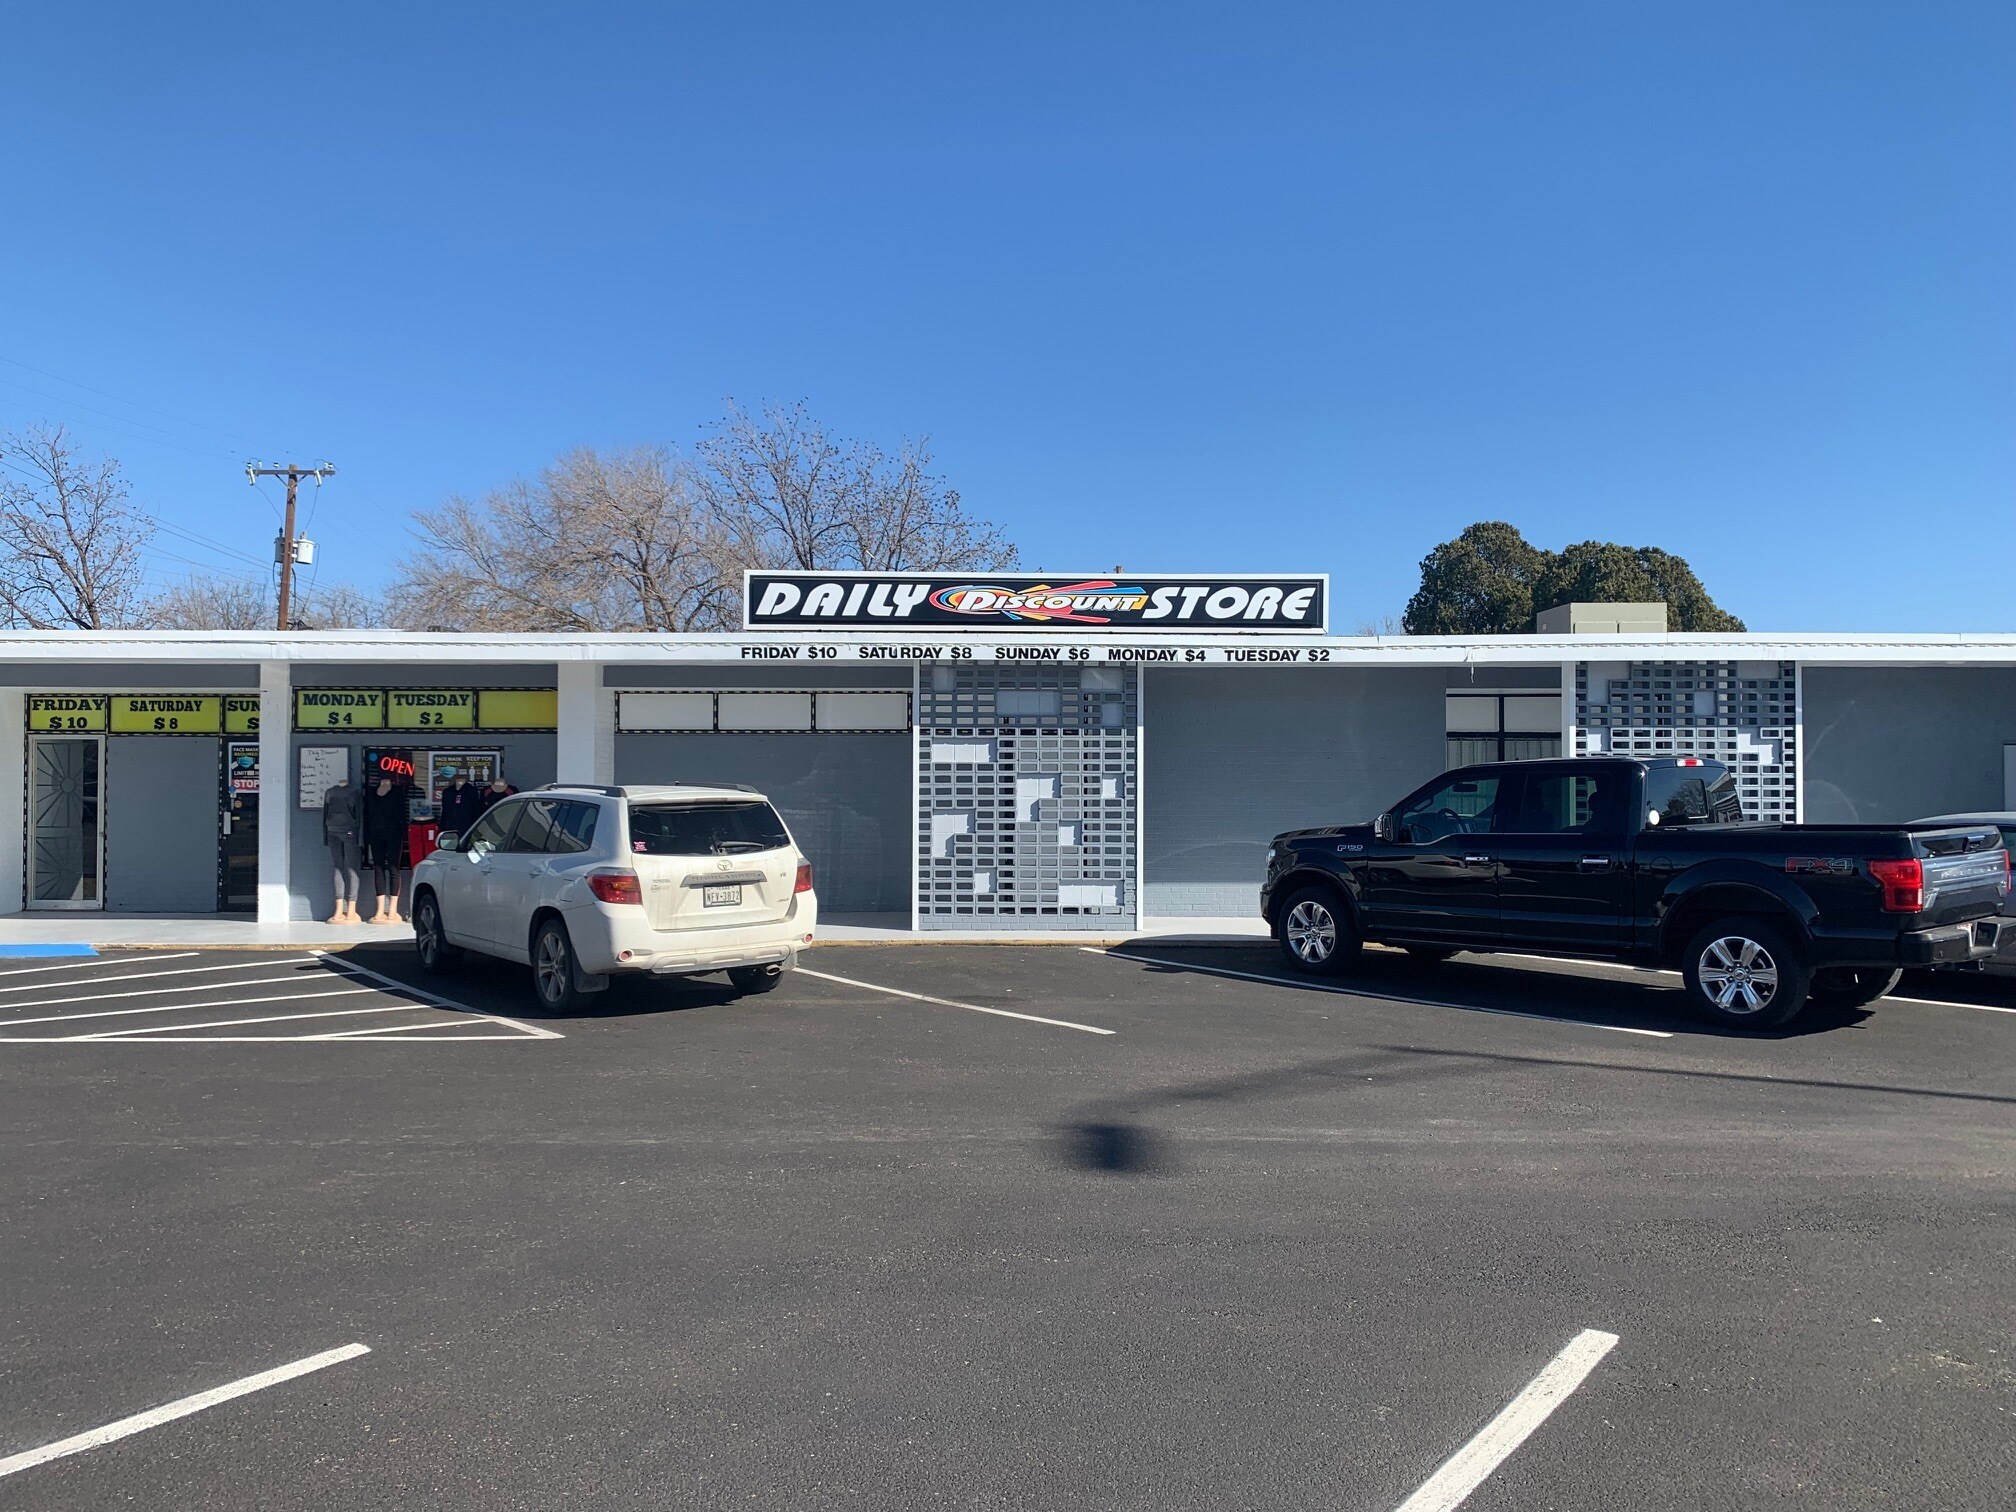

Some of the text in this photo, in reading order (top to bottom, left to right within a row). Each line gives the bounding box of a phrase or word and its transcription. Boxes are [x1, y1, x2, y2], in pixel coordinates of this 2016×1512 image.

[755, 582, 931, 617] DAILY
[1142, 586, 1316, 620] STORE
[741, 646, 1331, 662] FRIDAY $10 SATURDAY $8 SUNDAY $6 MONDAY $4 TUESDAY $2
[31, 698, 106, 712] FRIDAY
[129, 700, 203, 713] SATURDAY
[227, 699, 260, 712] SUN
[302, 693, 380, 707] MONDAY
[393, 693, 471, 707] TUESDAY
[380, 756, 416, 777] OPEN
